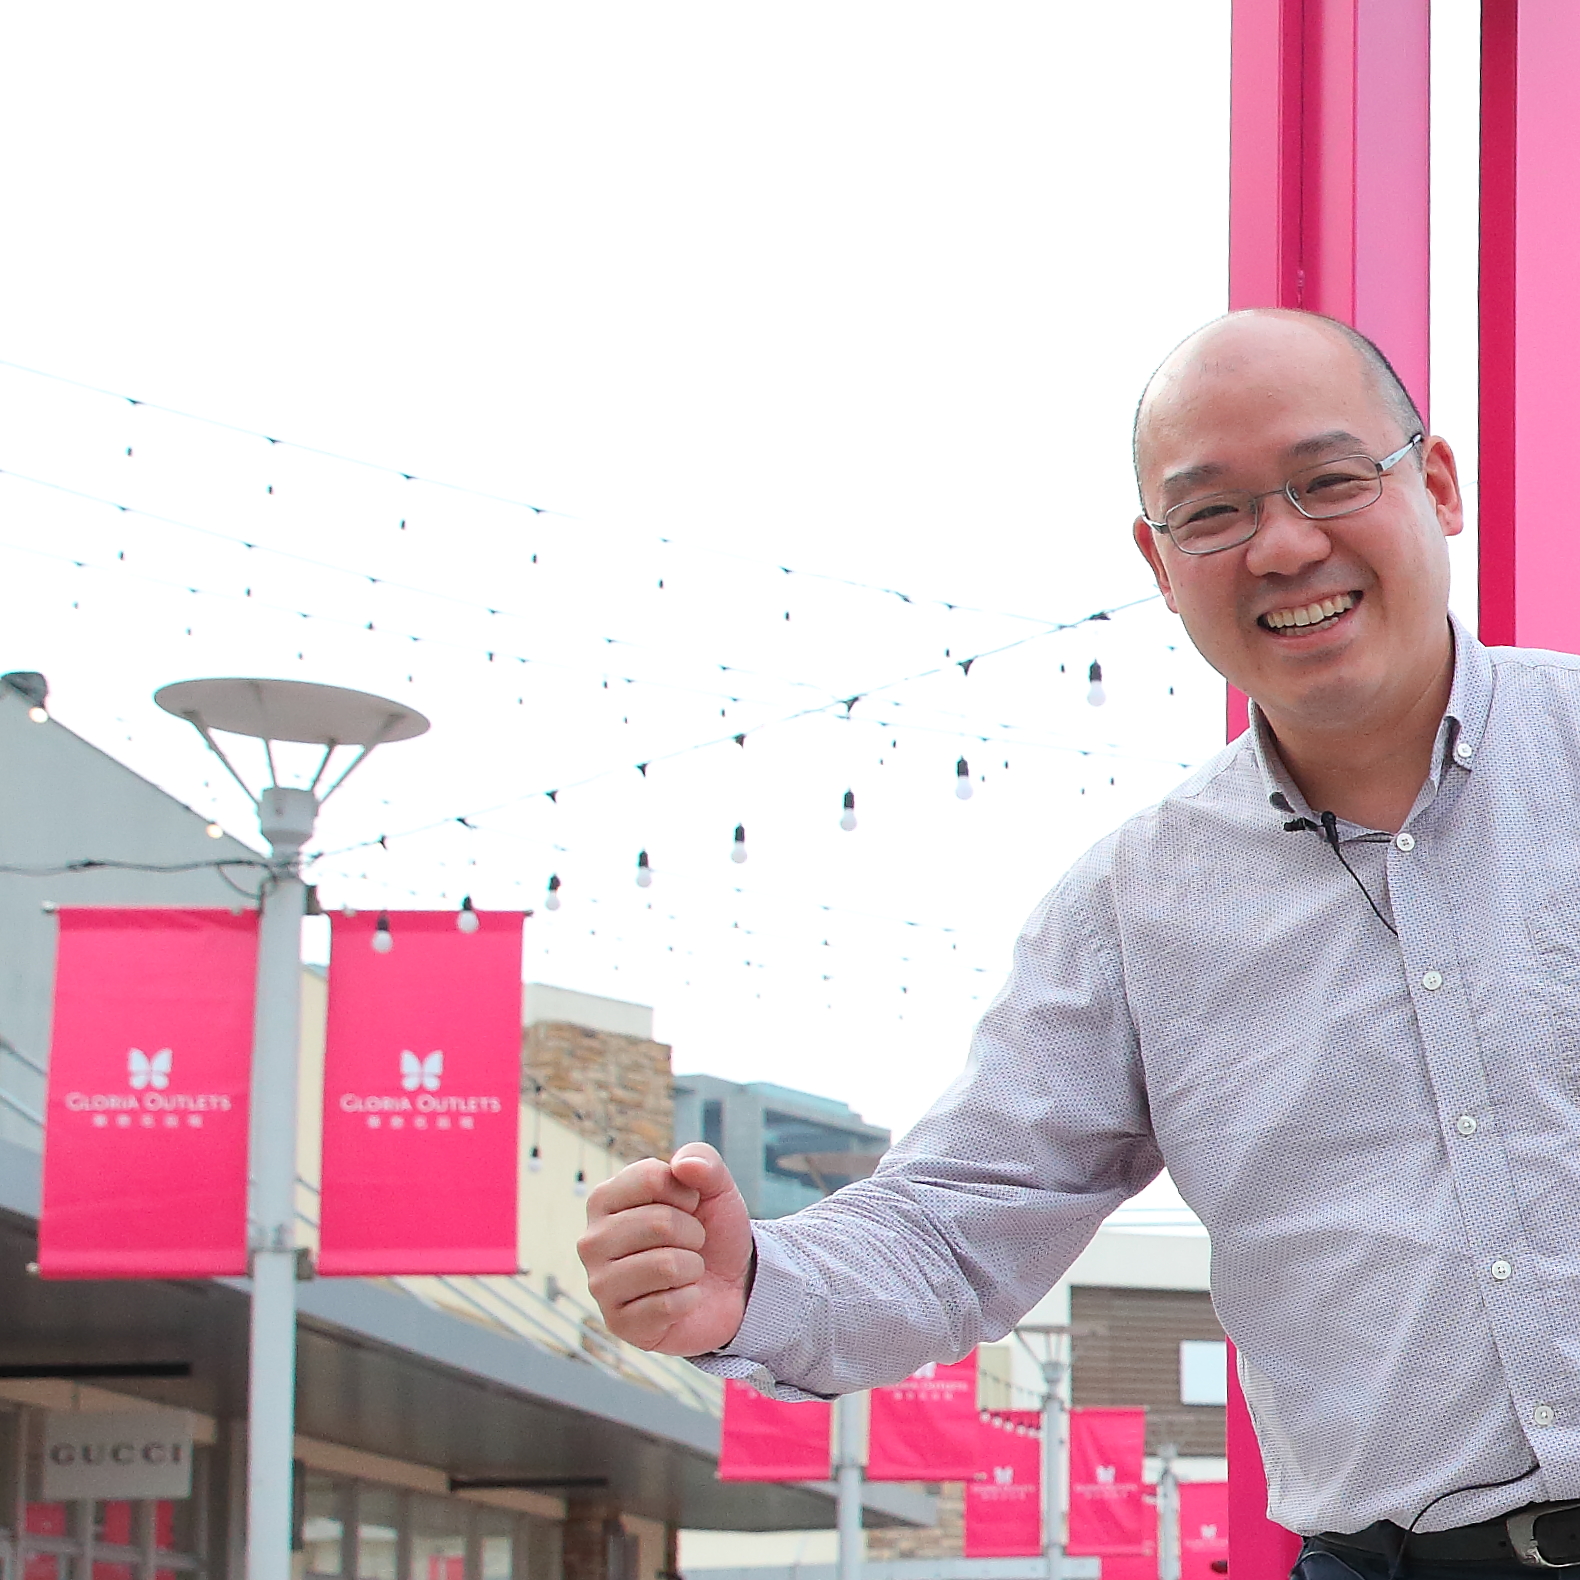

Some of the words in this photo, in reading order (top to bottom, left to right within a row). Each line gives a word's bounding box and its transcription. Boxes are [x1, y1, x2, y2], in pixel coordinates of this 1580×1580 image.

[65, 1092, 140, 1112] GLORIA
[143, 1091, 232, 1112] OUTLETS
[340, 1093, 413, 1113] GLORIA
[416, 1093, 502, 1113] OUTLETS
[51, 1441, 183, 1467] GUCCI
